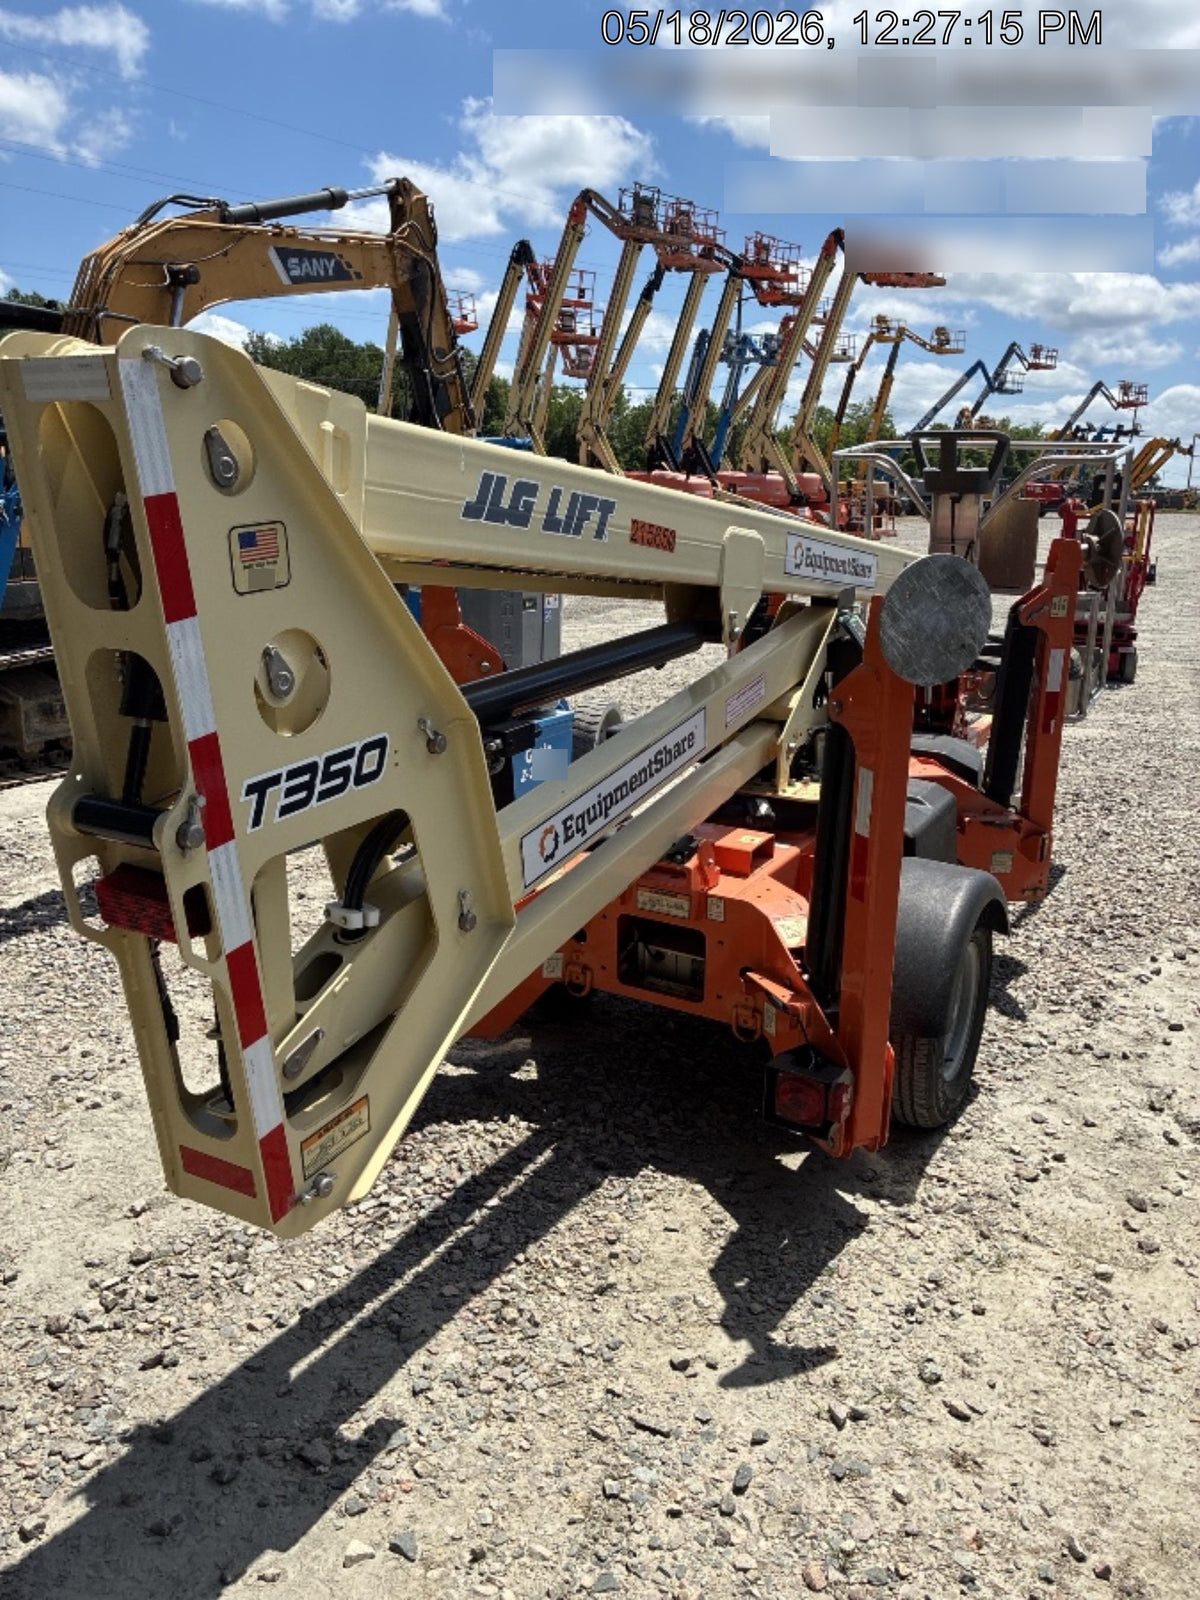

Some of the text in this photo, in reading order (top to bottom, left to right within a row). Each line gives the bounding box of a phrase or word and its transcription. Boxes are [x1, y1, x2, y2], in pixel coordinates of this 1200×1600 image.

[287, 257, 335, 277] SANY
[461, 469, 617, 542] JLG LIFT
[241, 732, 389, 834] T350
[561, 730, 695, 844] EquipmentShare
